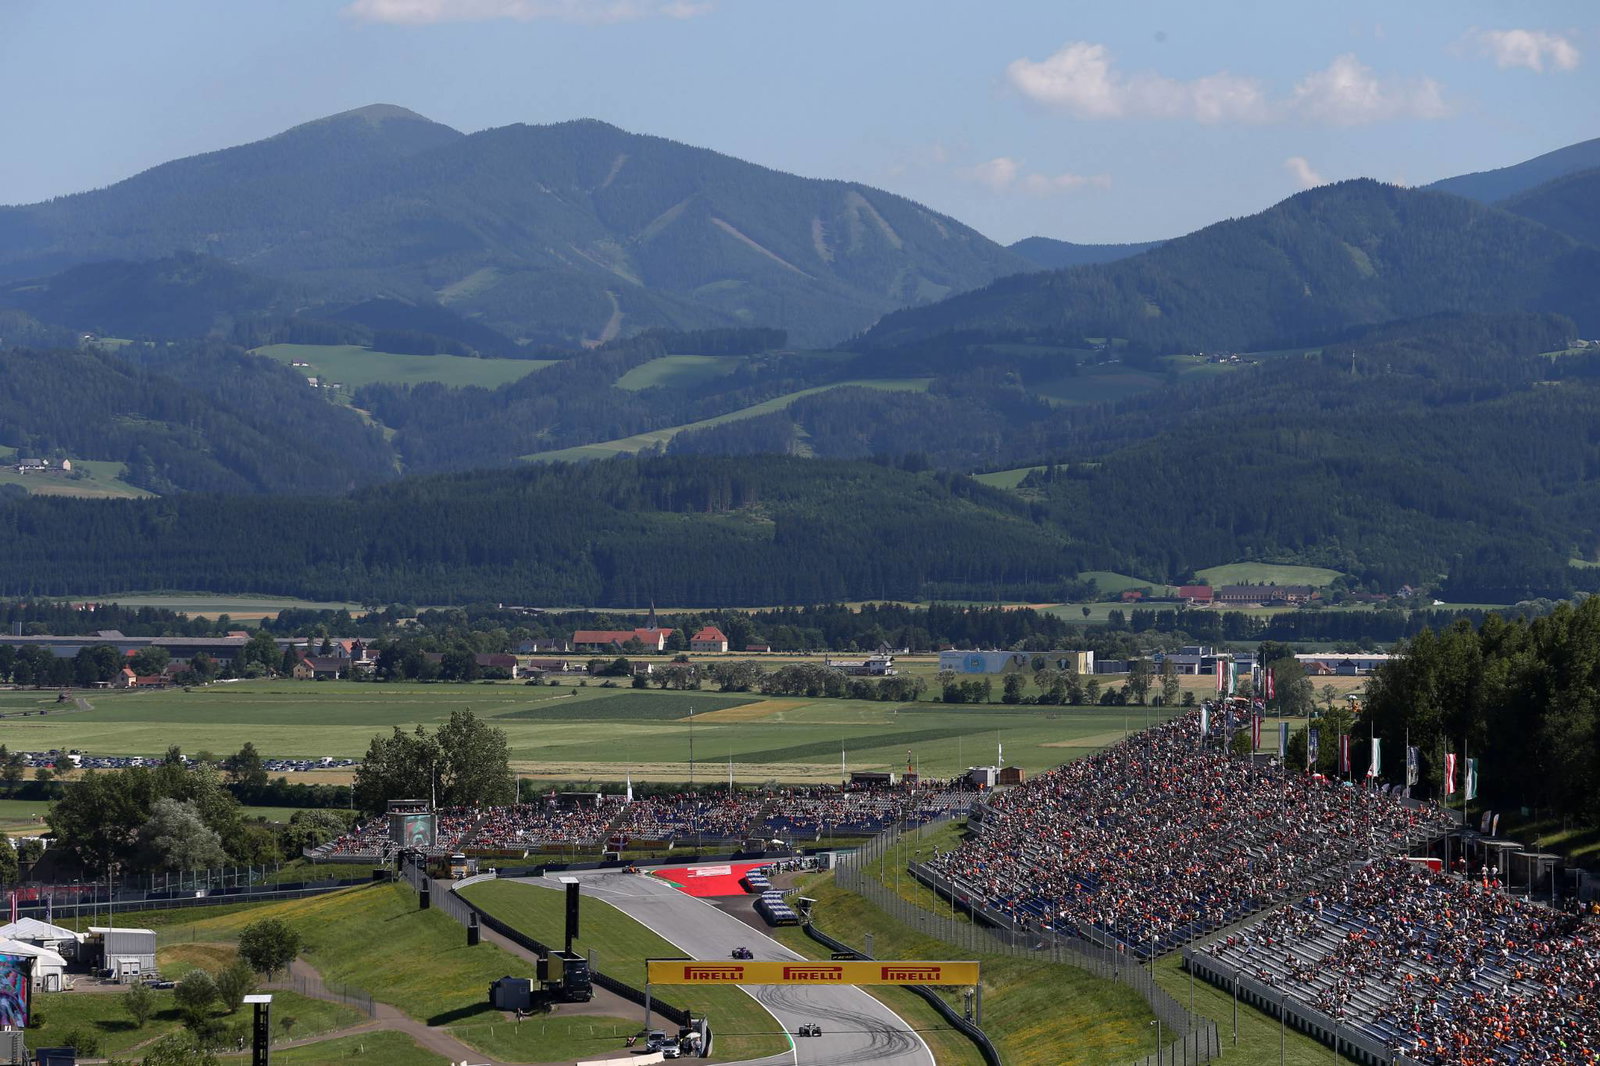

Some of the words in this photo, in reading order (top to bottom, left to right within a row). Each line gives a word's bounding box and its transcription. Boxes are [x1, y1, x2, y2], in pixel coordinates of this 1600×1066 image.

[684, 966, 744, 980] PIRELLI
[783, 966, 843, 980] PIRELLI
[881, 966, 941, 981] PIRELLI
